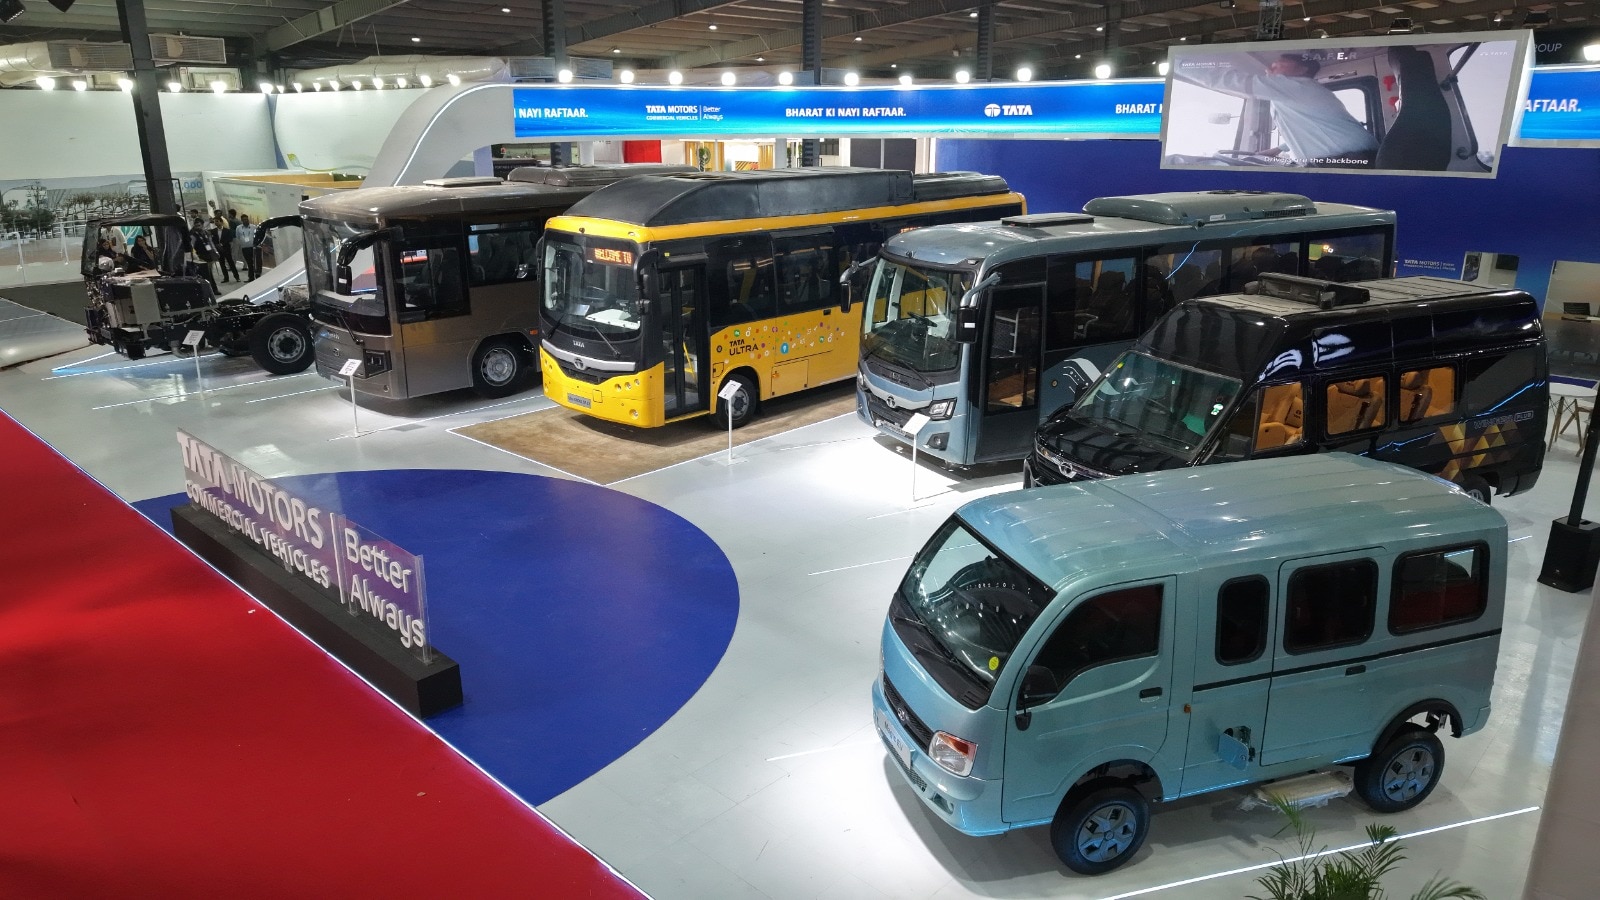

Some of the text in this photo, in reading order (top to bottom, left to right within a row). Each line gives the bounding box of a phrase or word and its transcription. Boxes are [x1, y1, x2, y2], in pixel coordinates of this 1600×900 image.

[1535, 43, 1562, 52] OUP
[646, 105, 698, 113] TATA MOTORS
[1002, 104, 1033, 116] TATA
[1115, 103, 1156, 114] BHARAT
[1524, 99, 1582, 112] AFTAAR.
[519, 108, 542, 118] NAYI
[544, 108, 589, 118] RAFTAAR.
[785, 107, 907, 117] BHARAT KI NAYI RAFTAAR.
[1325, 157, 1369, 165] backbone
[573, 340, 585, 348] TATA
[729, 339, 745, 347] TATA
[729, 344, 759, 356] ULTRA
[177, 431, 325, 549] TATA MOTORS
[184, 480, 331, 589] COMMERCIAL VEHICLES
[343, 527, 412, 594] Better
[350, 574, 426, 649] Always
